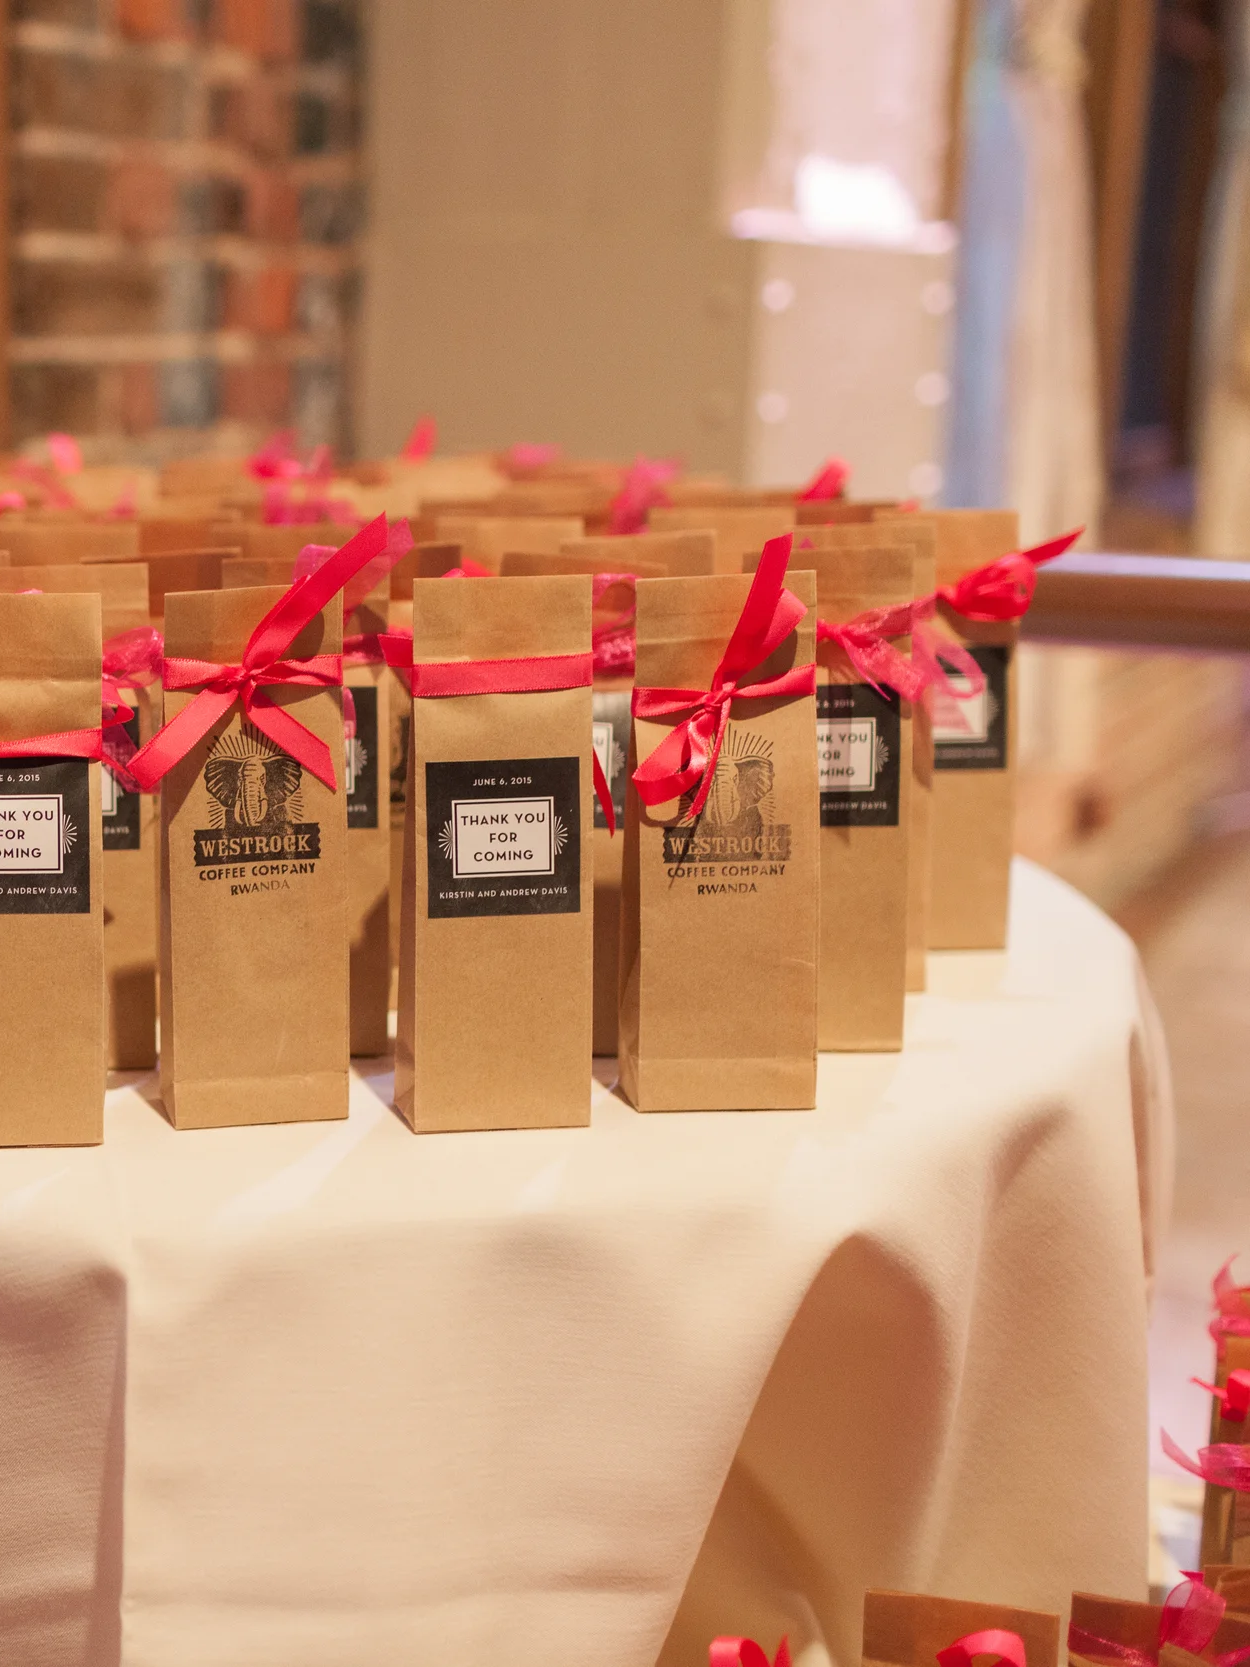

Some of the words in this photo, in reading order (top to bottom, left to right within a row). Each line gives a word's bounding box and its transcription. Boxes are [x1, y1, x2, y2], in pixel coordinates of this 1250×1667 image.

[838, 733, 868, 743] YOU
[819, 766, 855, 777] MING
[7, 774, 16, 783] 6,
[18, 774, 40, 782] 2015
[472, 778, 496, 787] JUNE
[499, 777, 508, 786] 6,
[510, 776, 532, 785] 2015
[861, 801, 888, 810] DAVIS
[23, 810, 54, 821] YOU
[460, 814, 509, 826] THANK
[514, 812, 546, 824] YOU
[489, 832, 518, 843] FOR
[200, 834, 312, 857] WESTROCK
[669, 836, 781, 855] WESTROCK
[473, 850, 534, 862] COMING
[199, 867, 246, 881] COFFEE
[251, 862, 316, 877] COMPANY
[667, 866, 716, 878] COFFEE
[721, 864, 786, 877] COMPANY
[7, 887, 47, 895] ANDREW
[50, 886, 78, 894] DAVIS
[230, 879, 290, 896] RWANDA
[439, 890, 475, 900] KIRSTIN
[477, 890, 497, 898] AND
[499, 888, 539, 897] ANDREW
[541, 886, 568, 895] DAVIS
[697, 882, 758, 895] RWANDA
